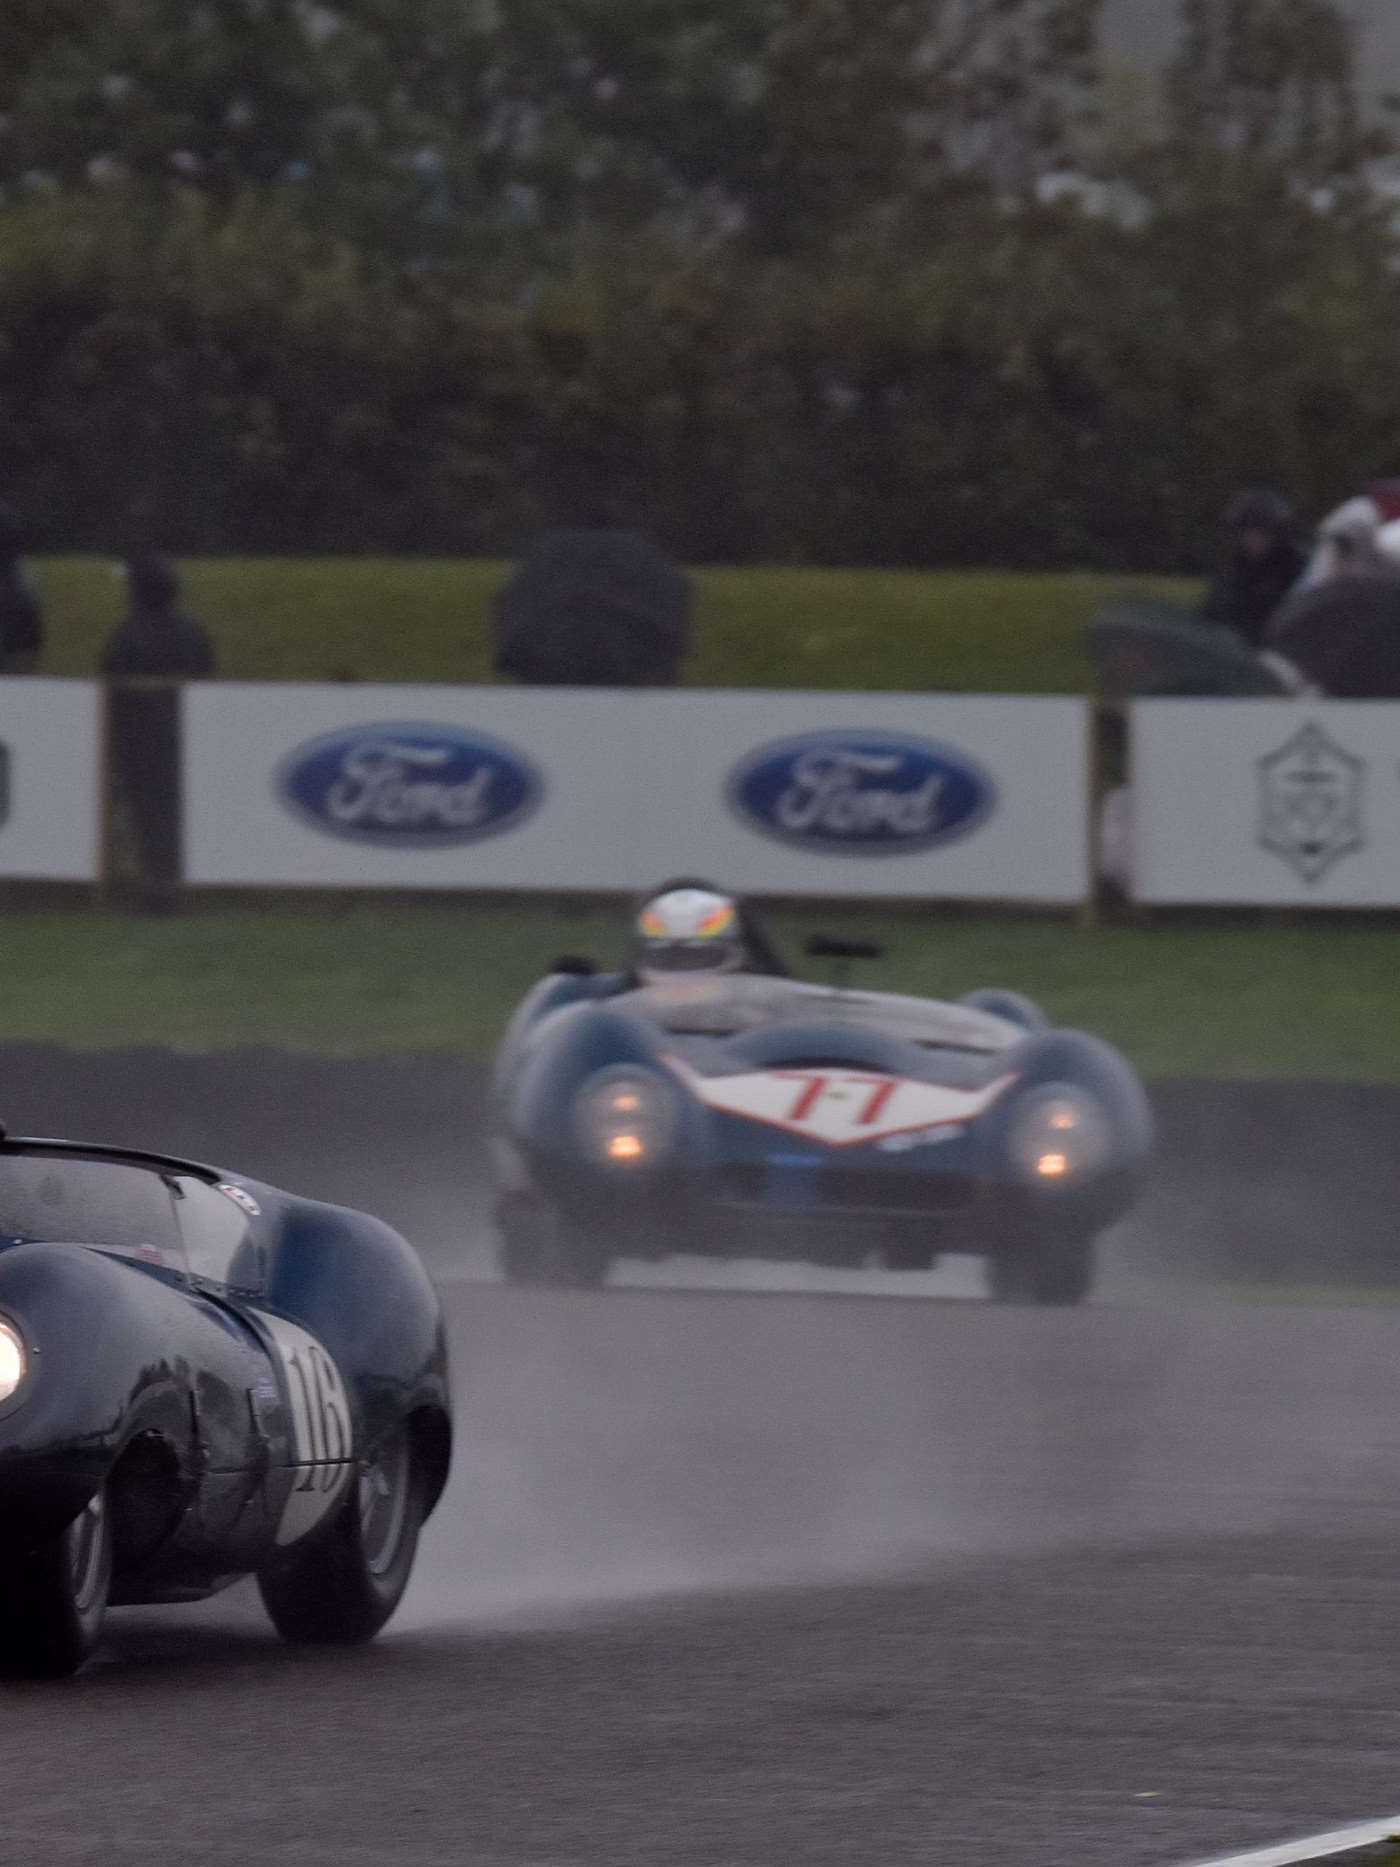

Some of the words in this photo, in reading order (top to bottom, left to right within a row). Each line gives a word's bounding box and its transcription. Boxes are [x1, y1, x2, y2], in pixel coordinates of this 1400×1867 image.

[326, 742, 488, 828] Ford
[774, 750, 942, 837] Ford
[768, 1068, 900, 1126] 77
[288, 1344, 352, 1493] 16
